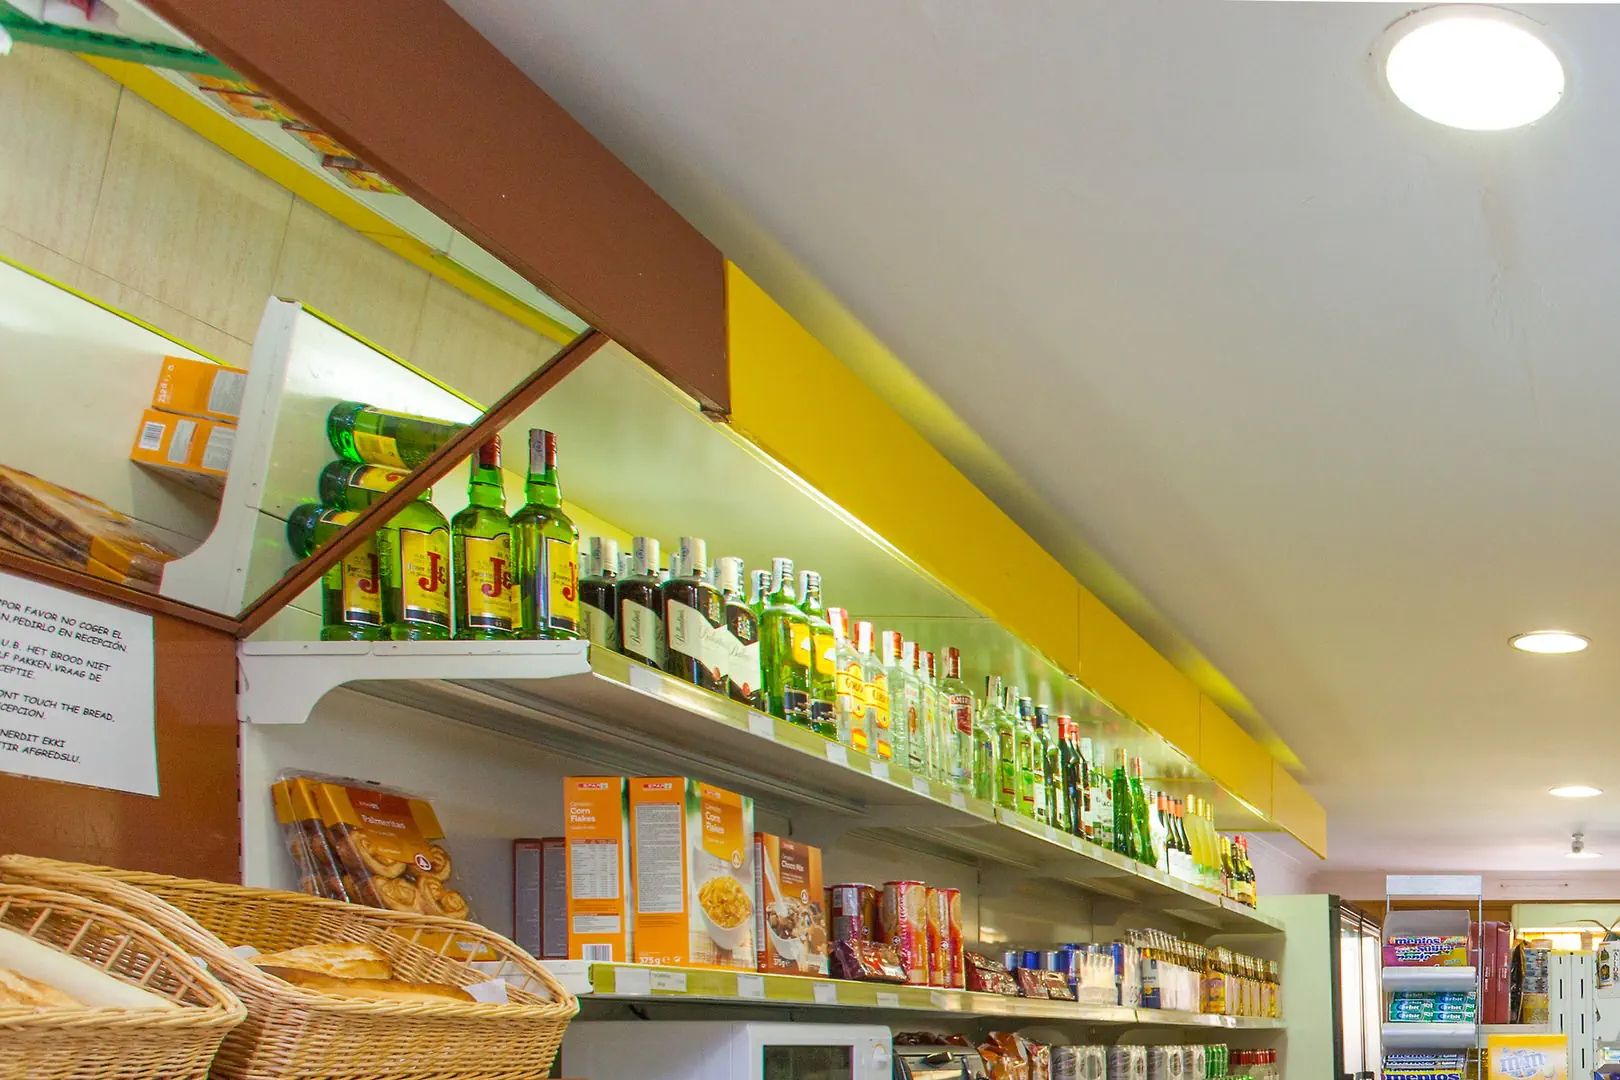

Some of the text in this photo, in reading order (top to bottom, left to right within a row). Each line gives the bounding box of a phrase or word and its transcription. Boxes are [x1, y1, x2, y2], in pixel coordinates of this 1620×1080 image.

[25, 606, 58, 621] FAVOR
[61, 616, 77, 626] NO
[80, 622, 110, 636] COGER
[112, 630, 122, 639] EL
[58, 627, 73, 639] EN
[27, 645, 48, 656] HET
[51, 650, 83, 665] BROOD
[86, 659, 111, 672] NIET
[88, 672, 102, 682] DE
[23, 694, 58, 708] TOUCH
[61, 702, 81, 714] THE
[41, 736, 66, 748] EKKI
[570, 807, 591, 815] Corn
[704, 811, 721, 823] Corn
[570, 814, 596, 822] Flakes
[706, 822, 725, 834] Flakes
[1393, 936, 1441, 946] mentos
